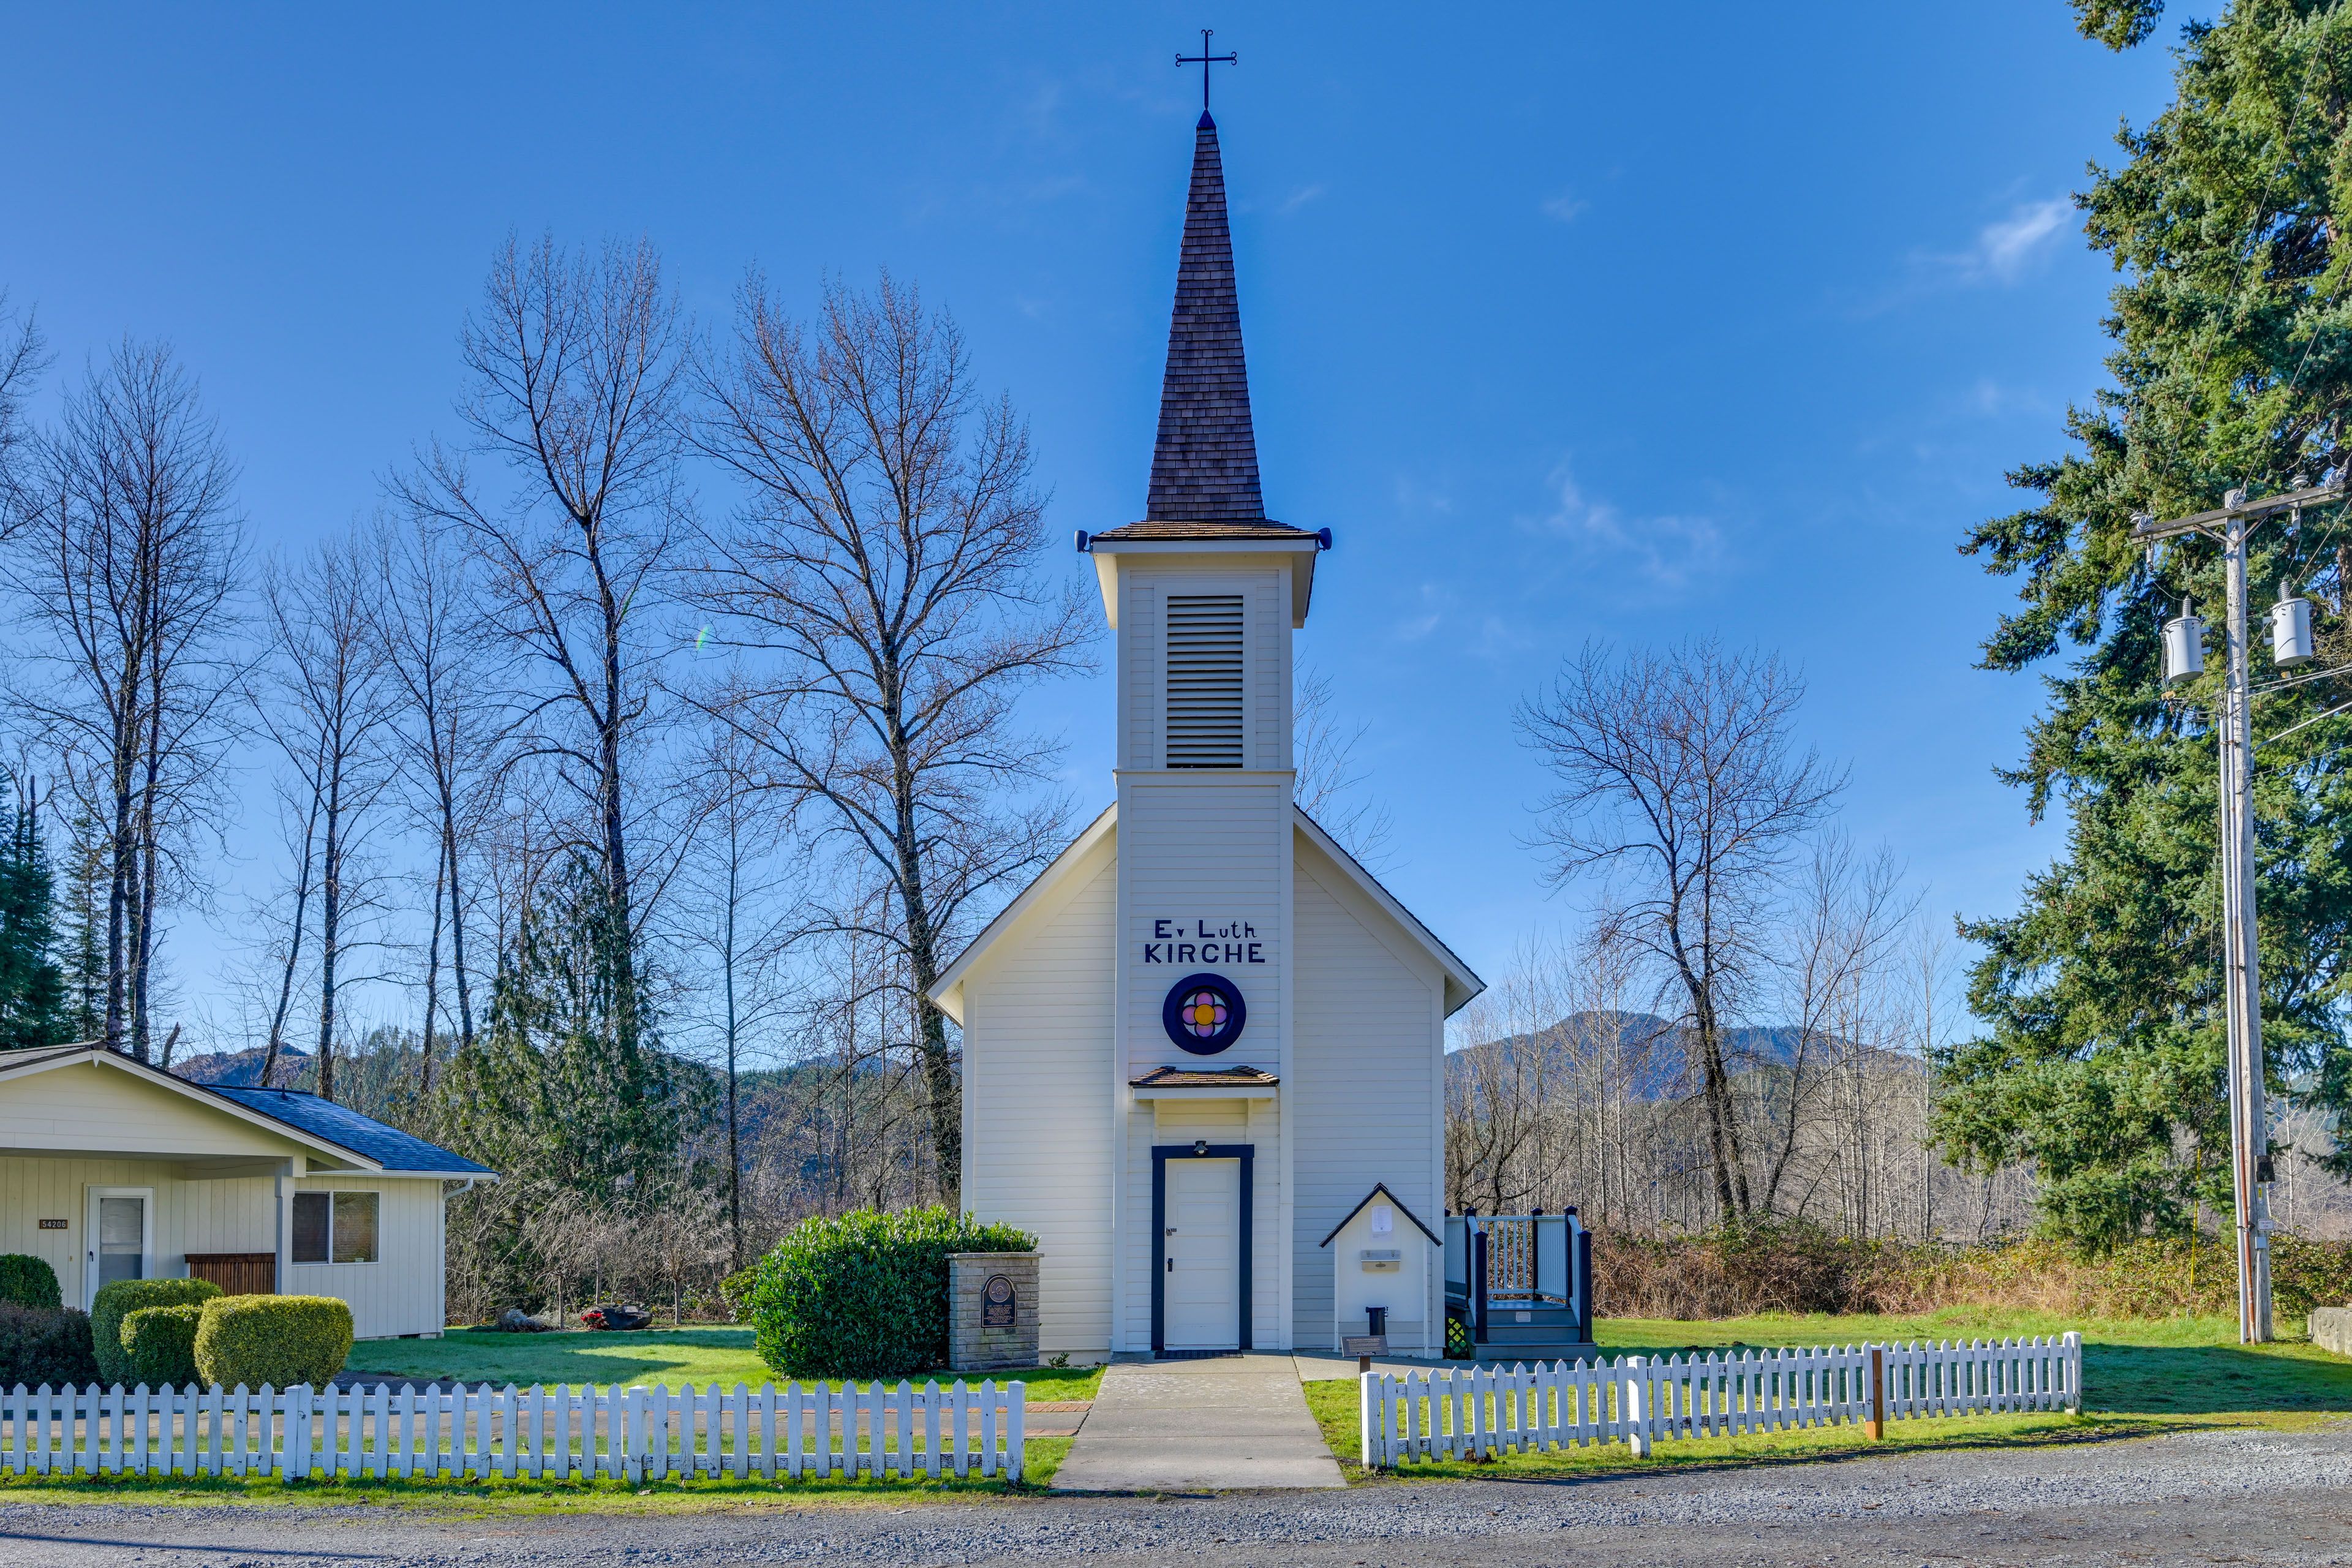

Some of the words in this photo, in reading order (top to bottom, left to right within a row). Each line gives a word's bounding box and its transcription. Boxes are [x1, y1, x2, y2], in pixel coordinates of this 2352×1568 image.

[1155, 919, 1185, 939] Ev
[1198, 919, 1257, 939] Luth
[1145, 943, 1265, 964] KIRCHE
